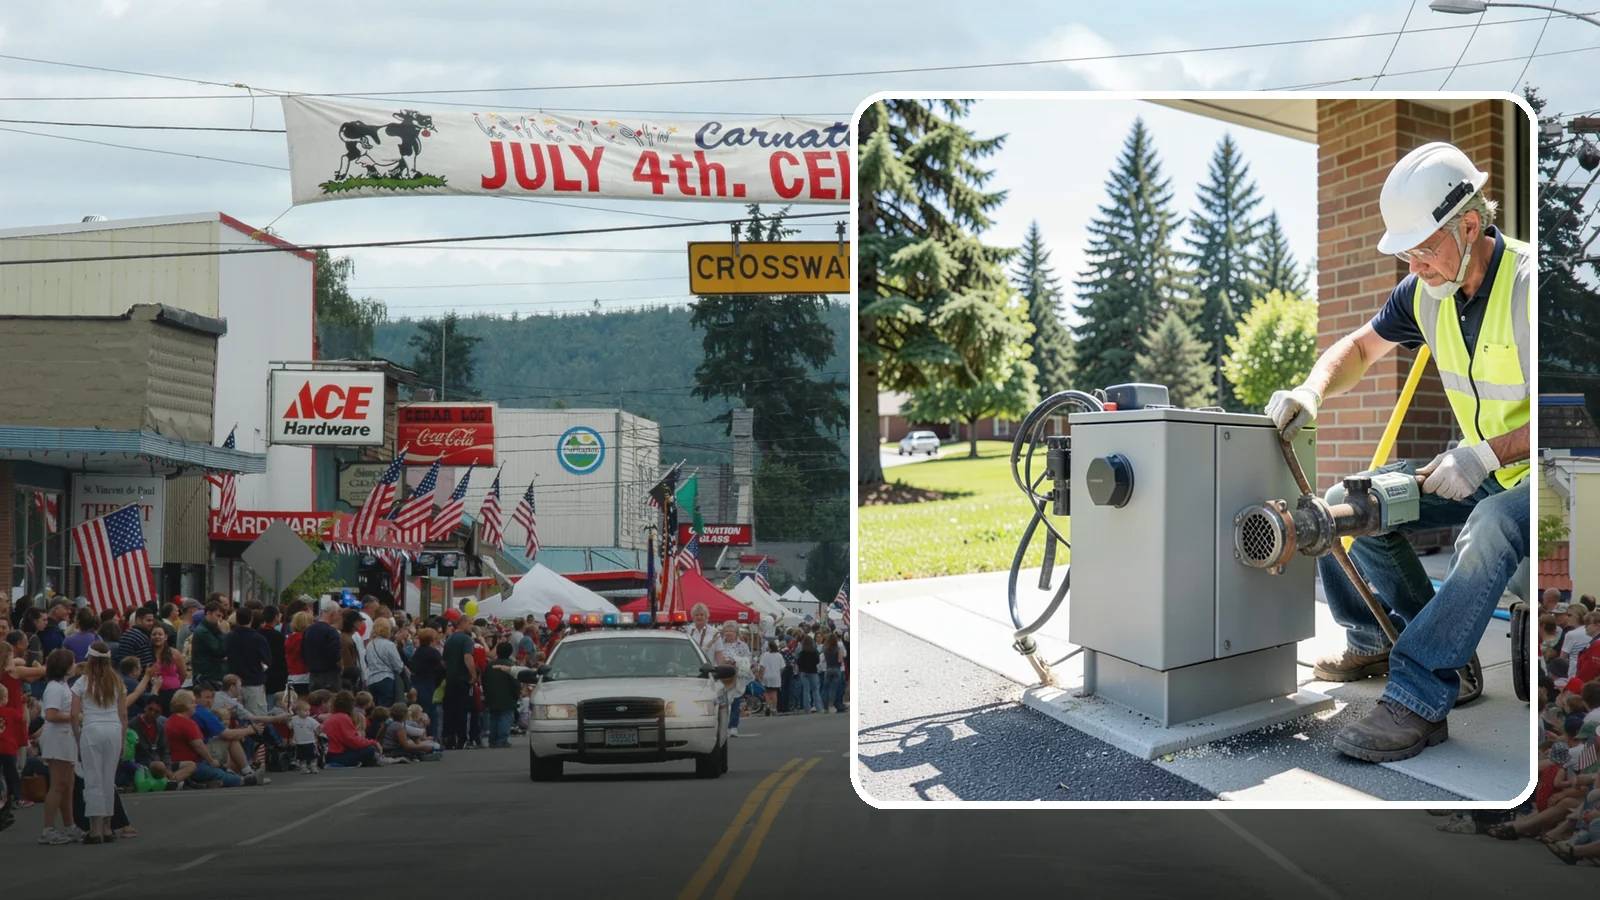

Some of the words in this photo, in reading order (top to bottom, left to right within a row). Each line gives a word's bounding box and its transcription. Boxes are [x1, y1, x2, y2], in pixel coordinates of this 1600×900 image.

[481, 140, 605, 193] JULY
[632, 150, 746, 198] 4th.
[696, 253, 850, 280] CROSSWA
[282, 379, 374, 420] ACE
[405, 409, 452, 422] CEDAR
[461, 409, 485, 422] LOG
[283, 420, 371, 436] Hardware
[416, 428, 477, 447] Coca-Cola
[96, 485, 124, 494] Vincent
[126, 486, 136, 495] de
[138, 486, 155, 495] Paul
[699, 535, 730, 543] GLASS
